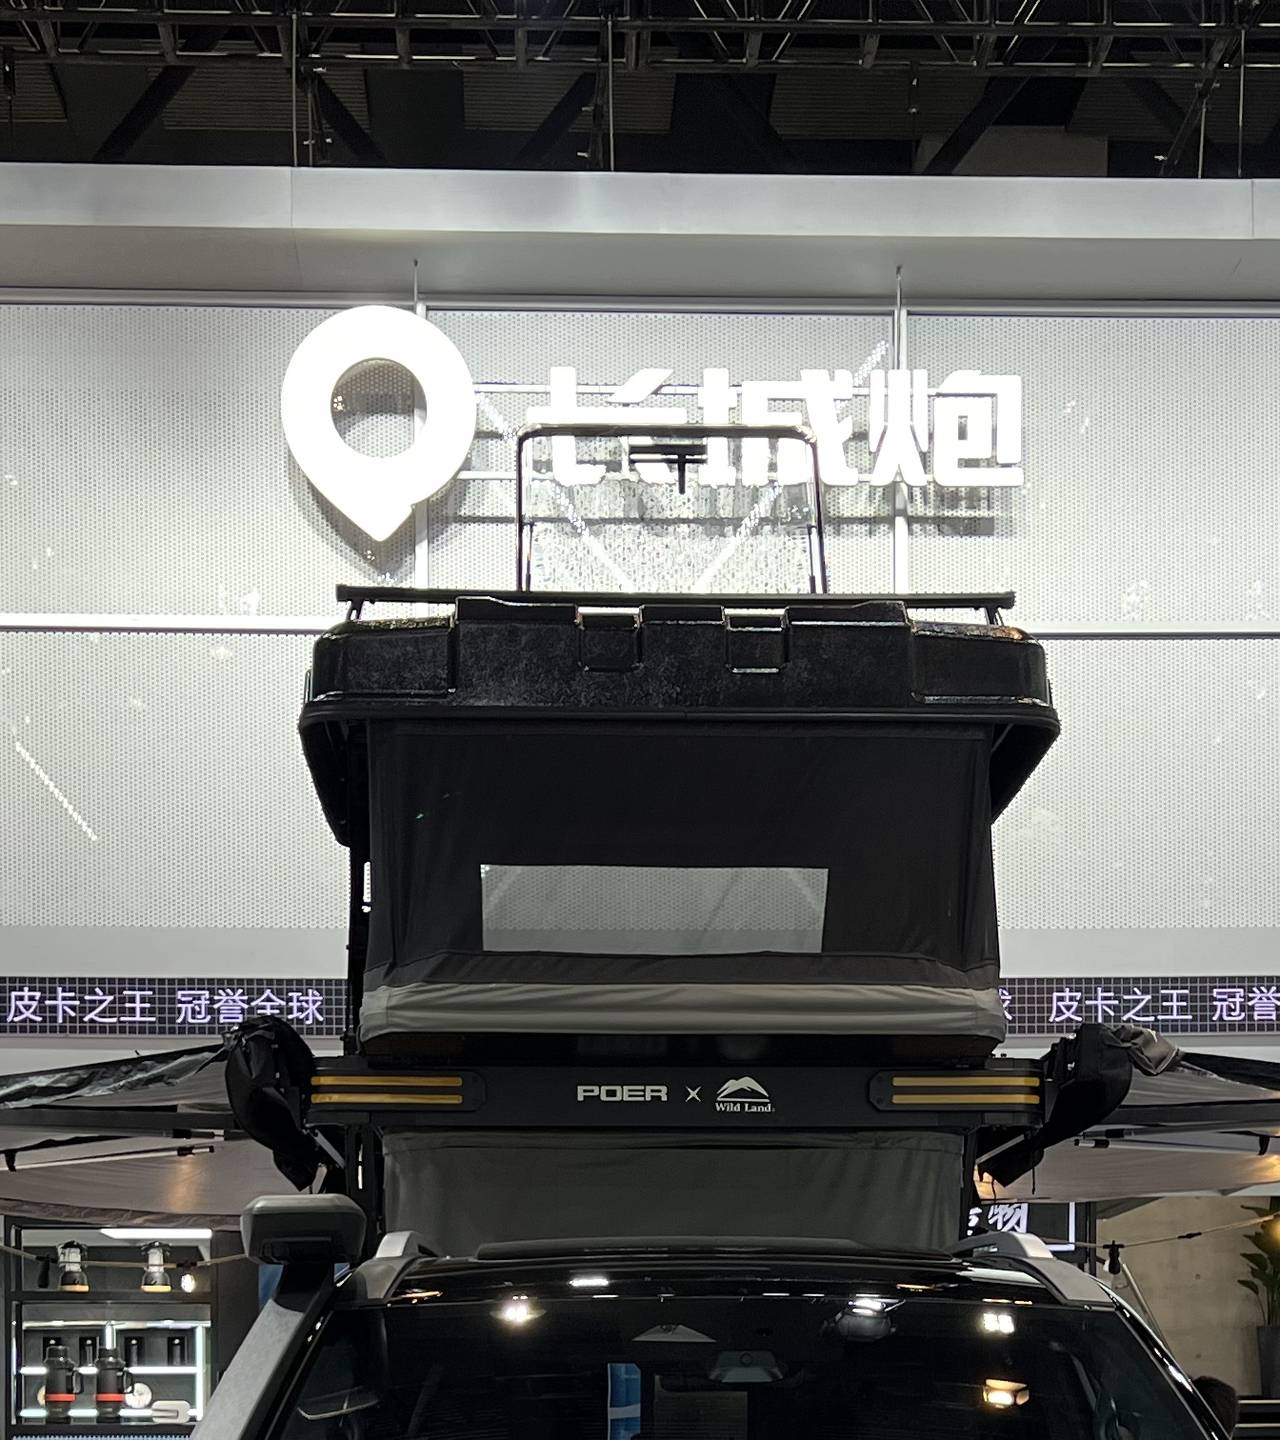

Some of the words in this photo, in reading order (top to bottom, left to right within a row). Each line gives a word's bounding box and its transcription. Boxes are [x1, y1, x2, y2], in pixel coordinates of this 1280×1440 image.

[7, 987, 155, 1022] 皮卡之王
[176, 988, 323, 1024] 冠誉全球
[1049, 987, 1192, 1022] 皮卡之王
[577, 1086, 668, 1101] POER
[715, 1103, 740, 1112] Wild
